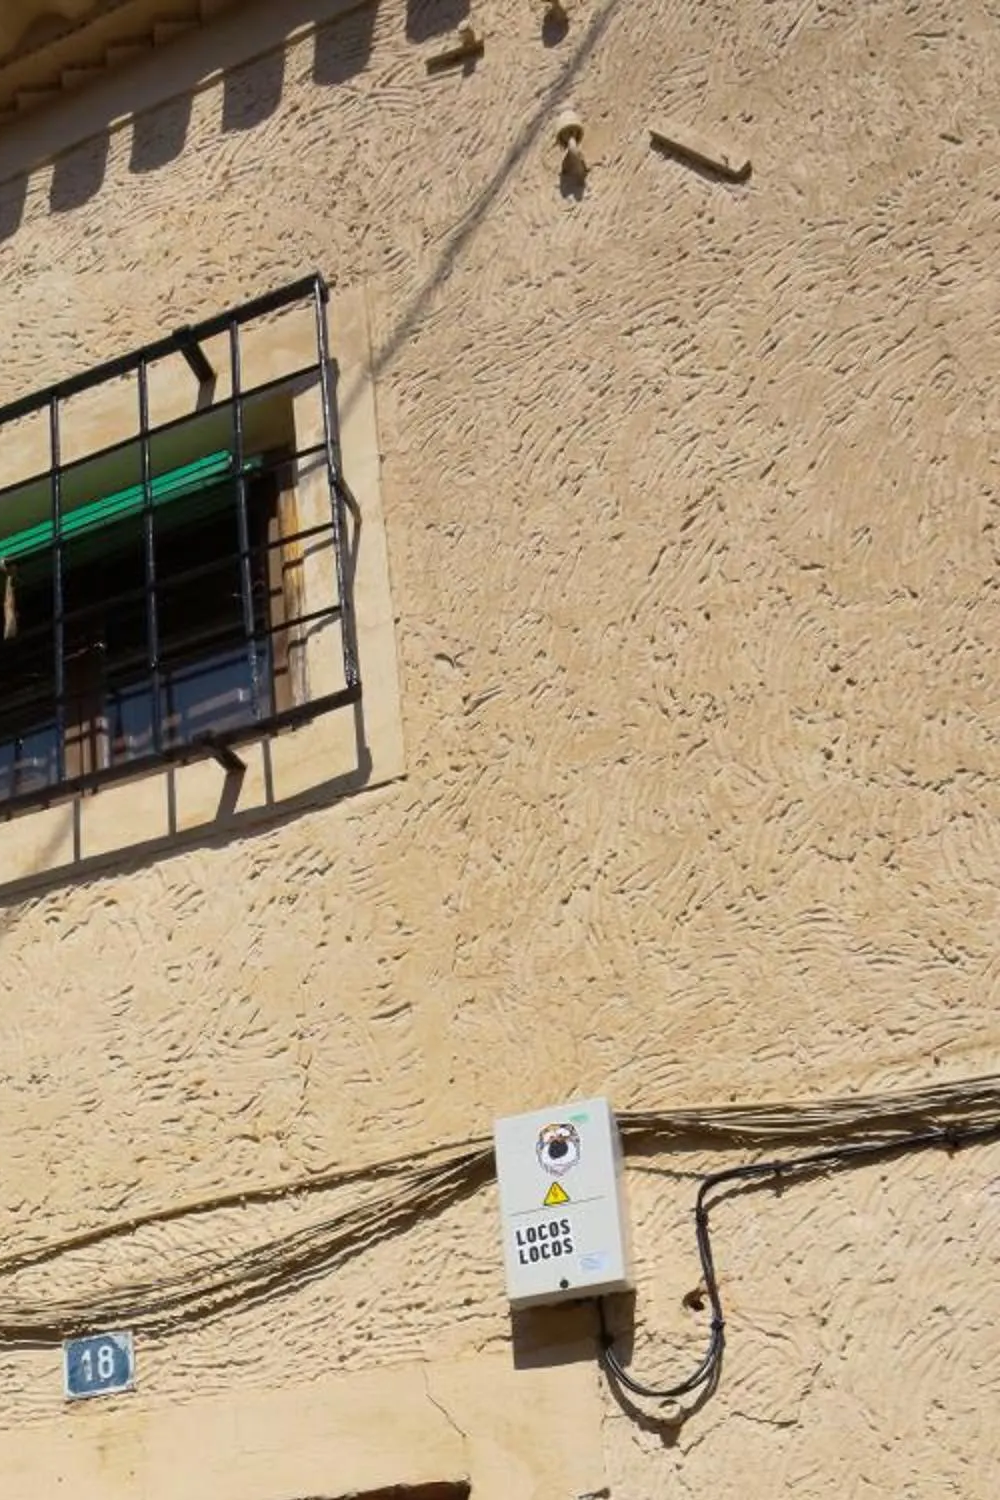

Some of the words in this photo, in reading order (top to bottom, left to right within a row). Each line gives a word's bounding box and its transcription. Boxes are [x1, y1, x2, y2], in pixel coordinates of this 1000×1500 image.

[516, 1219, 571, 1246] LOCOS
[519, 1238, 574, 1265] LOCOS
[81, 1345, 114, 1381] 18
